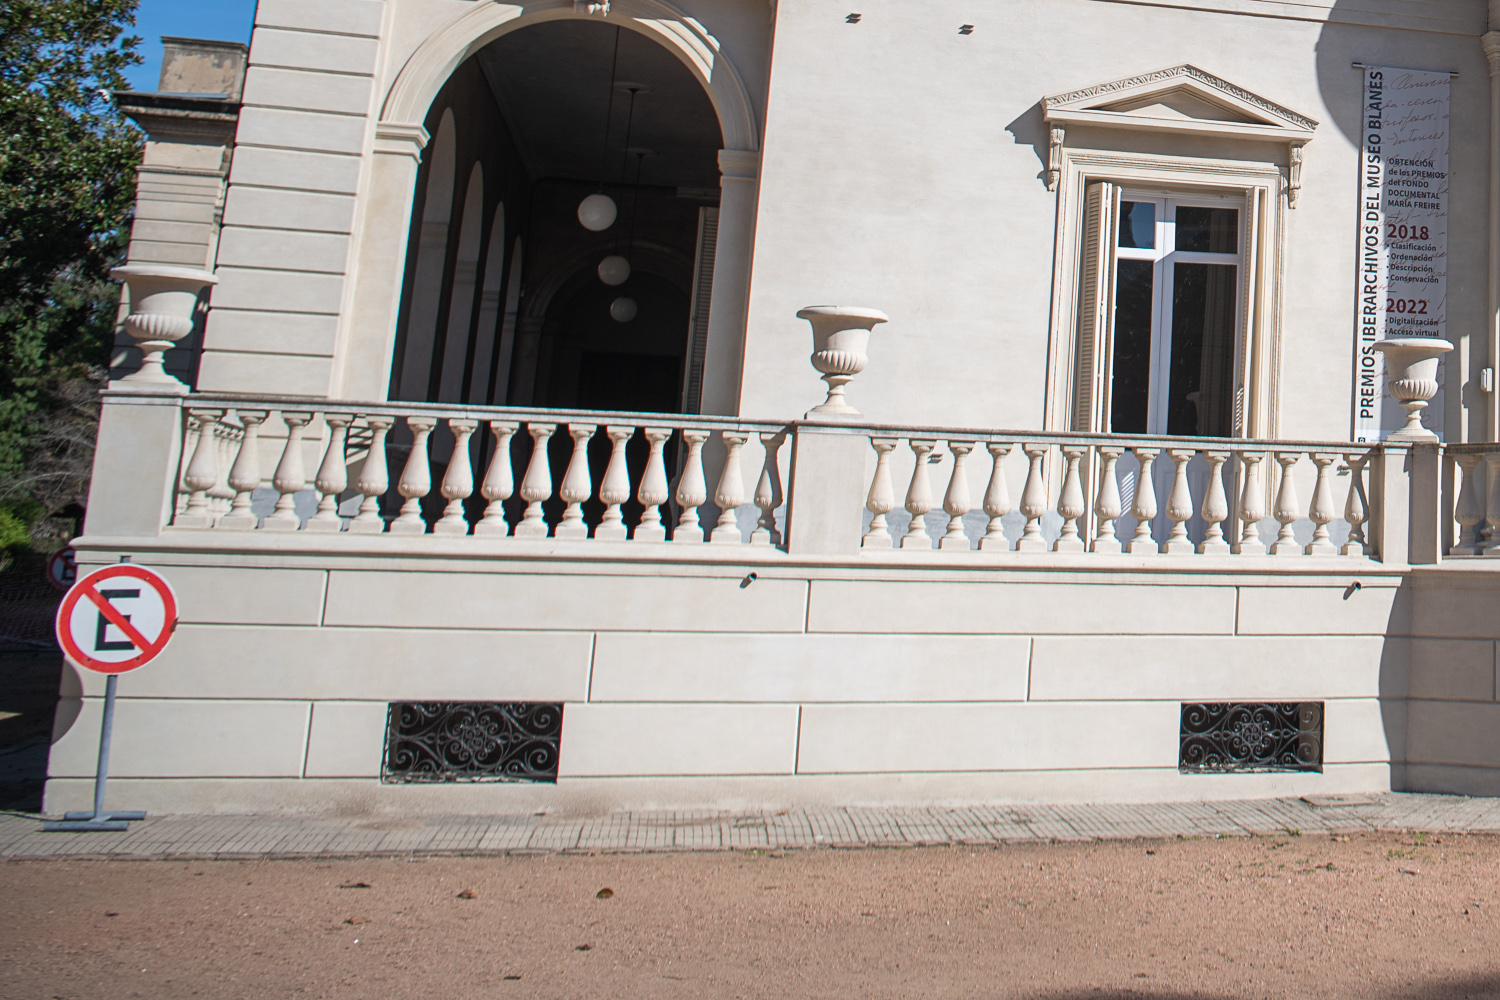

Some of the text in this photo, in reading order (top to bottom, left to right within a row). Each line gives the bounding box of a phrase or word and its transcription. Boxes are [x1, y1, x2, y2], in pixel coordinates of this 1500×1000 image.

[1388, 157, 1434, 168] OBTENCIÓN
[1388, 168, 1445, 179] de los PREMIOS
[1402, 180, 1429, 188] FONDO
[1388, 189, 1440, 199] DOCUMENTAL
[1388, 198, 1441, 210] MARÍA FREIRE
[1387, 223, 1430, 240] 2018
[1360, 71, 1383, 418] PREMIOS IBERARCHIVOS DEL MUSEO BLANES
[1391, 242, 1437, 252] Clasificación
[1390, 252, 1433, 262] Ordenación
[1390, 264, 1433, 273] Descripción
[1390, 274, 1439, 284] Conservación
[1386, 298, 1428, 314] 2022
[1389, 317, 1439, 326] Digitalización
[1388, 327, 1440, 337] Acceso virtual
[94, 588, 141, 651] E
